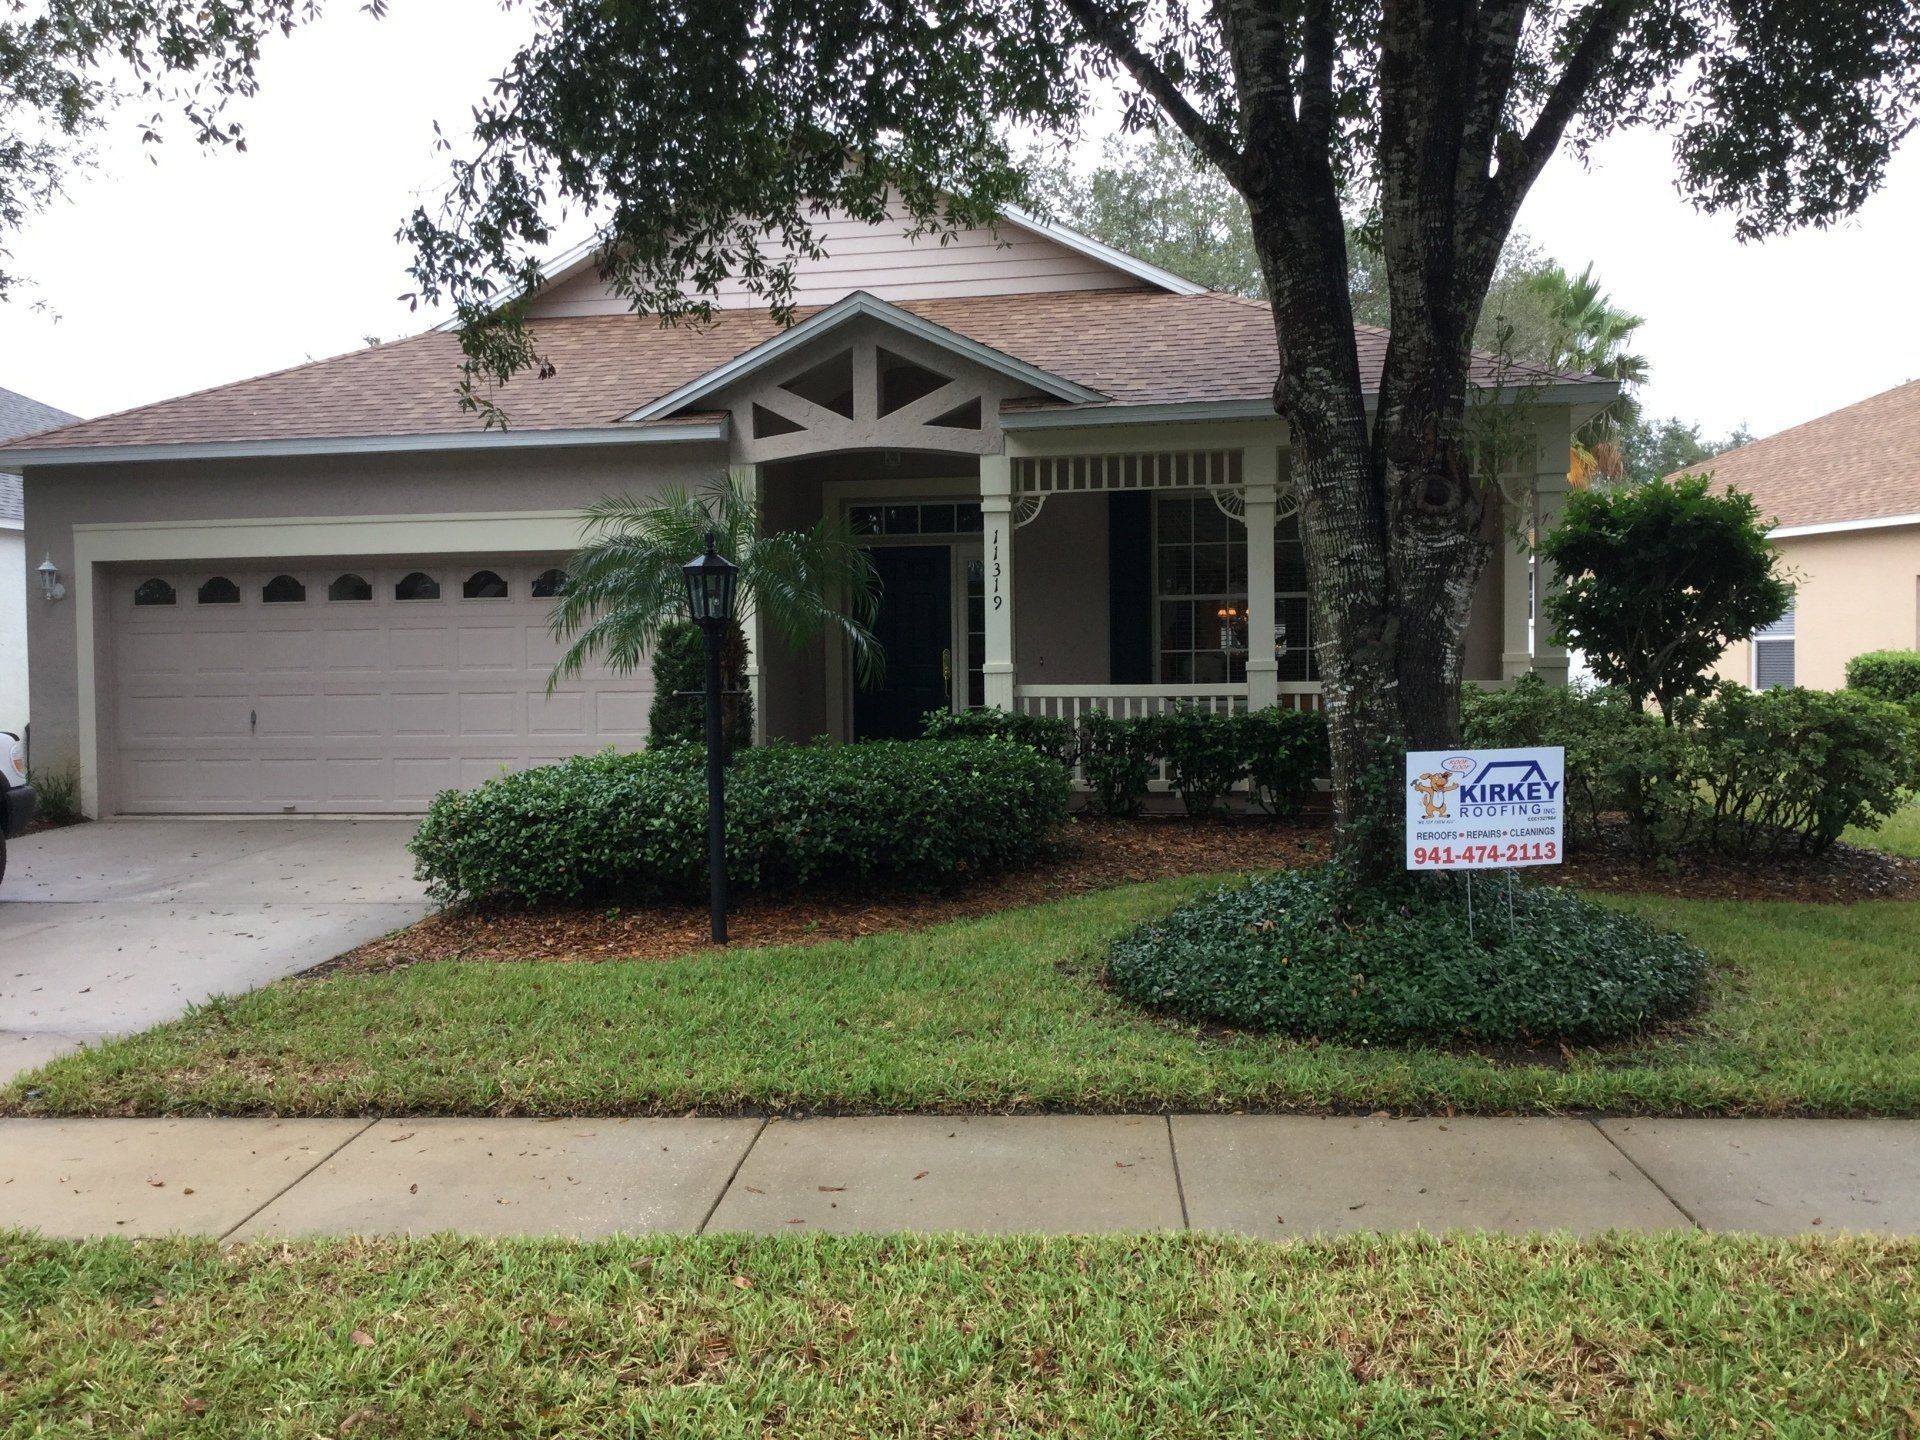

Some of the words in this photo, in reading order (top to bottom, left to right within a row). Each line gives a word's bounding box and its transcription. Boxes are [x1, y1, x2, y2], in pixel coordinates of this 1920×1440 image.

[993, 529, 1002, 611] 11319
[1460, 781, 1560, 803] KIRKEY
[1460, 804, 1541, 817] ROOFING
[1543, 807, 1556, 815] INC
[1416, 831, 1458, 840] REROOFS
[1466, 828, 1502, 839] REPAIRS
[1510, 827, 1556, 837] CLEANINGS
[1414, 842, 1556, 865] 941-474-2113
